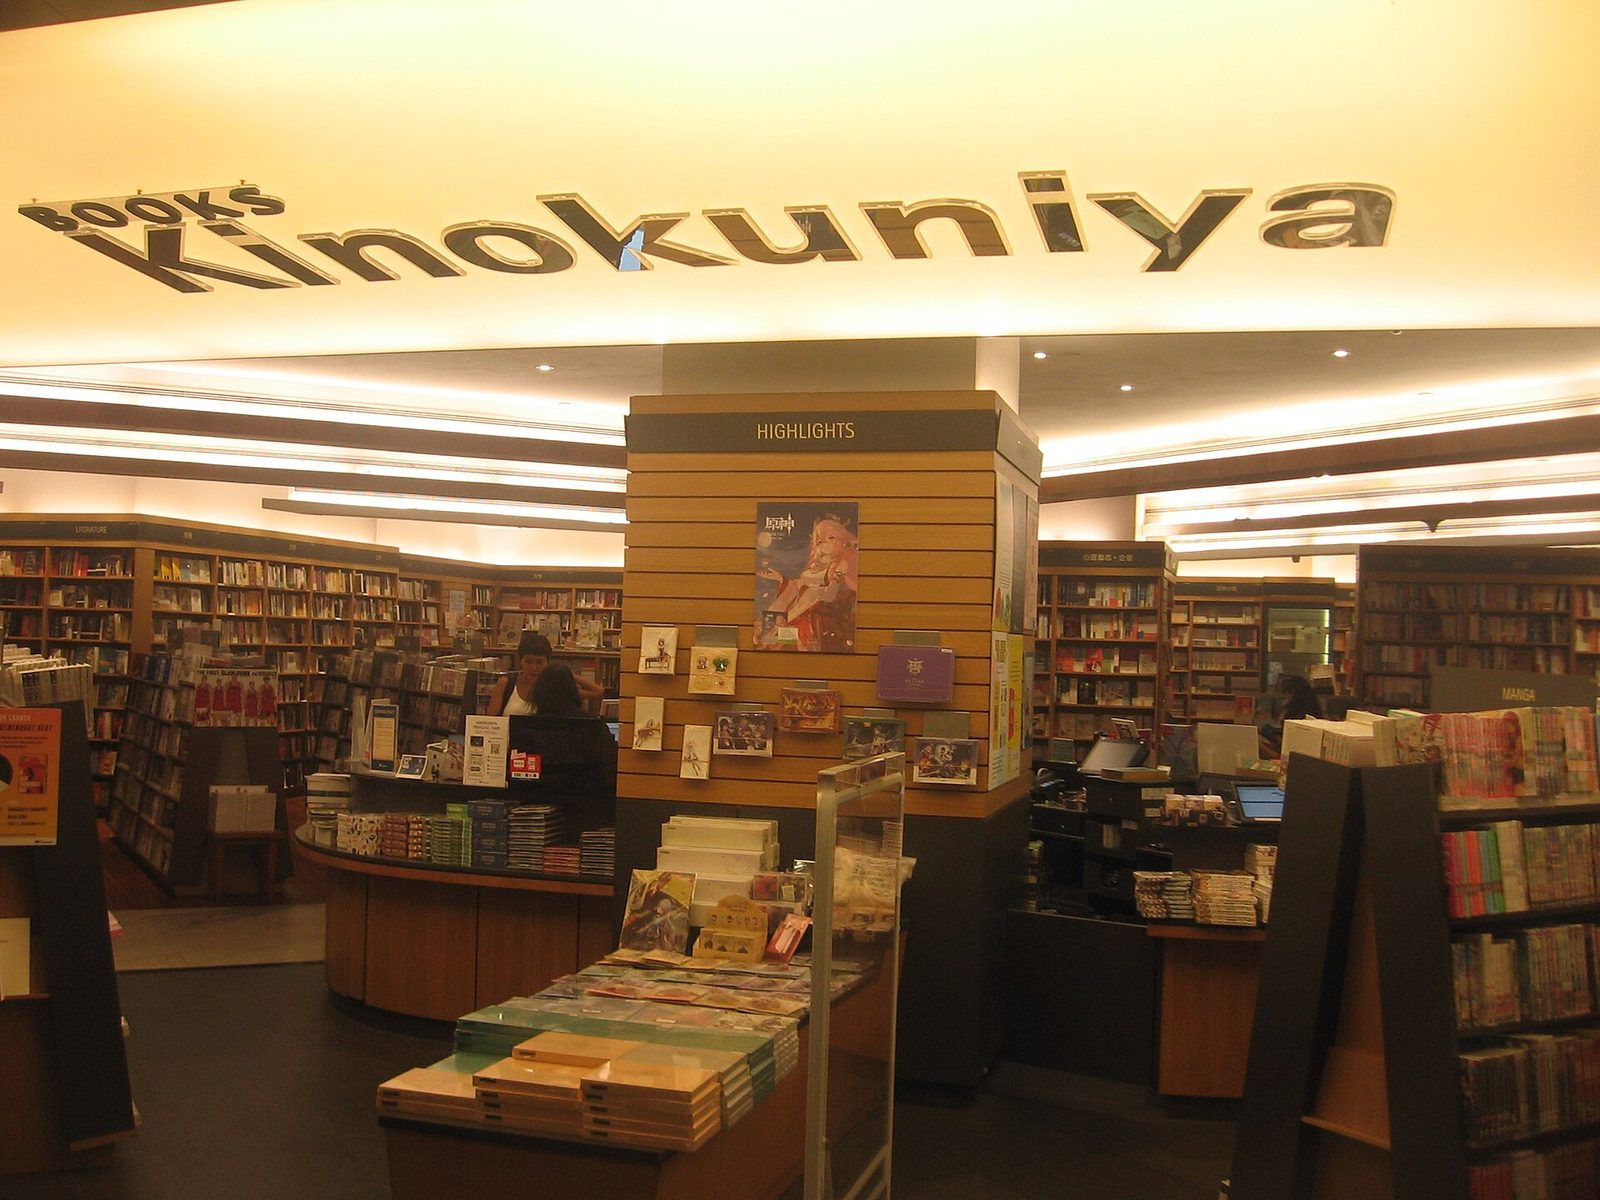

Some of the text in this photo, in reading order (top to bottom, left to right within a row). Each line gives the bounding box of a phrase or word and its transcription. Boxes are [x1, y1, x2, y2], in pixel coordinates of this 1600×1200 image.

[19, 184, 286, 232] BOOKS
[64, 169, 1397, 293] Kinokuniya
[757, 422, 855, 439] HIGHLIGHTS
[1502, 687, 1537, 701] MANGA
